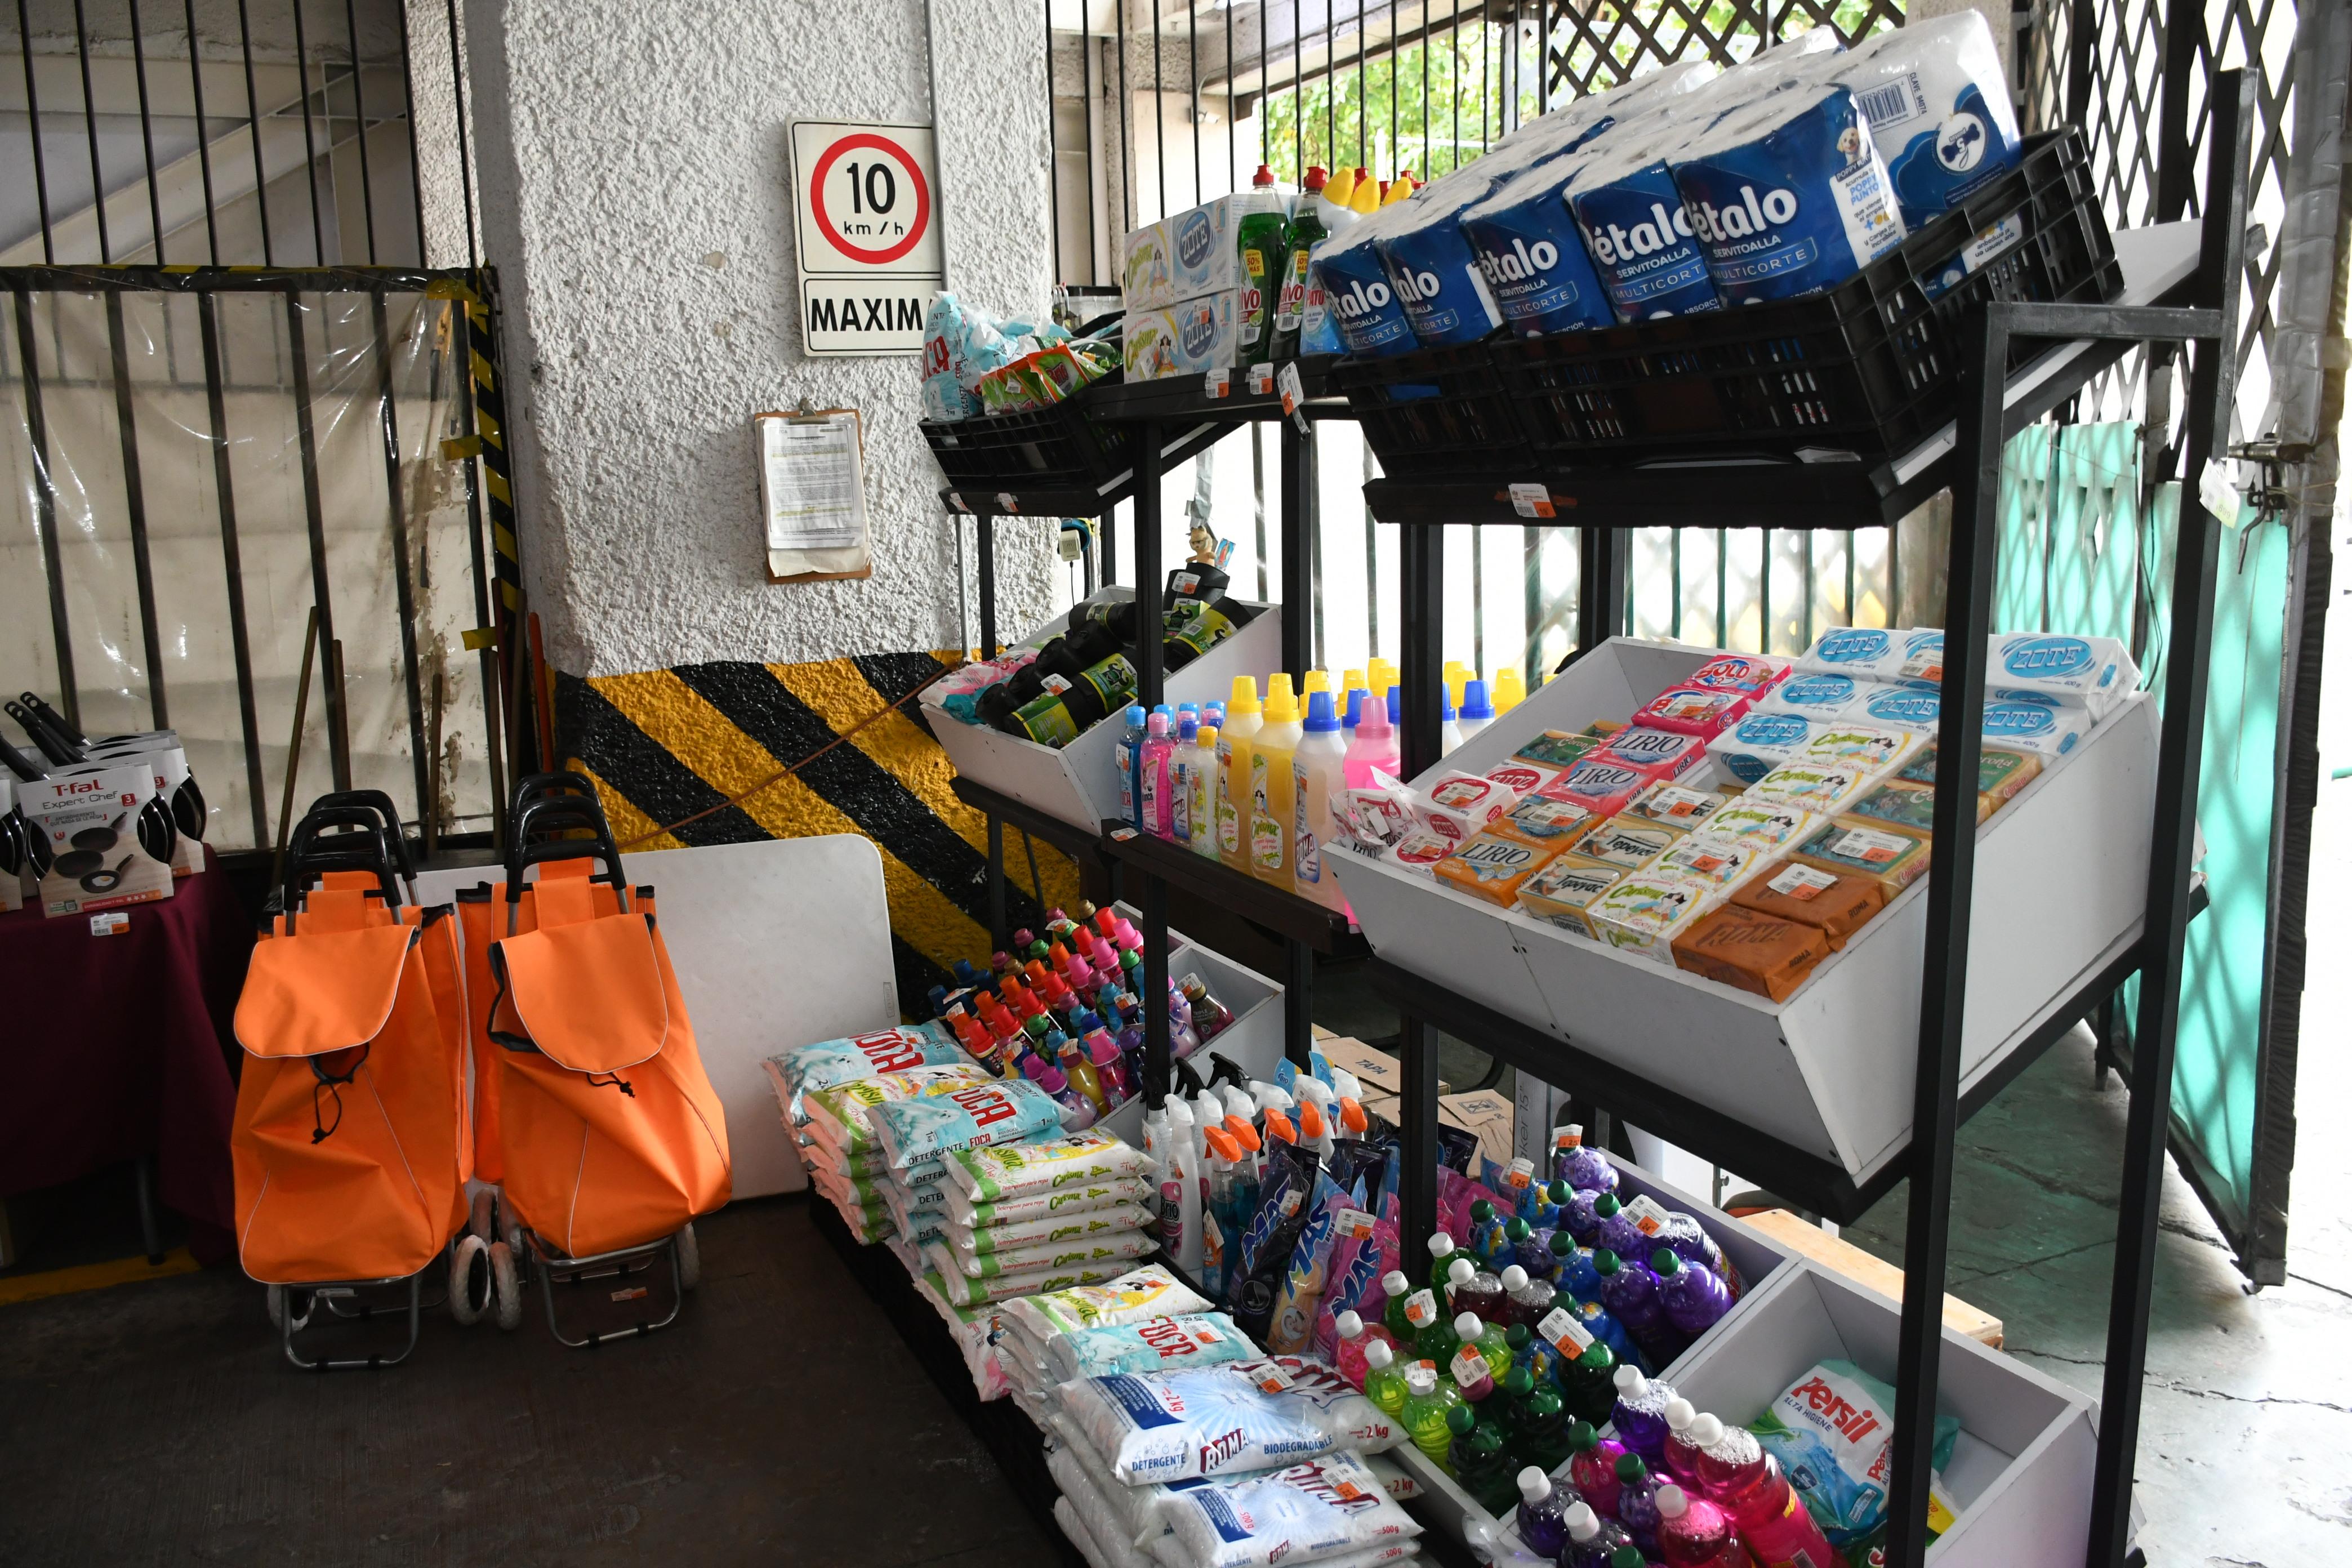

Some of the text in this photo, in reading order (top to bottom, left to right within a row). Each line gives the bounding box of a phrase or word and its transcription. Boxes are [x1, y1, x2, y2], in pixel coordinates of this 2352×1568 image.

[1909, 72, 1928, 115] CLAVE 94074
[1948, 127, 1967, 142] puntos
[1956, 139, 1969, 154] 5
[1837, 162, 1857, 180] POPPY
[1845, 171, 1869, 189] Acumula
[847, 162, 896, 215] 10
[1850, 173, 1877, 196] POPPY
[1851, 182, 1880, 206] PUNTO
[1692, 185, 1797, 243] étalo
[1854, 208, 1865, 219] que
[1865, 204, 1885, 219] empaq
[844, 221, 903, 235] km/h
[1182, 218, 1208, 261] ZOTE
[1713, 235, 1782, 259] SERVITOALLA
[1975, 231, 2015, 258] que vienen en
[1976, 231, 2004, 250] empaque
[1247, 257, 1260, 268] 50%
[1478, 238, 1558, 284] étalo
[1616, 247, 1691, 279] SERVITOALLA
[1713, 248, 1807, 280] MULTICORTE
[1393, 267, 1440, 303] alo
[1499, 279, 1548, 297] SERVITOALLA
[1615, 264, 1701, 299] MULTICORT
[1240, 286, 1260, 310] lvo
[1281, 282, 1304, 302] alvo
[1326, 280, 1390, 320] talo
[811, 298, 932, 332] MAXIM
[1684, 297, 1718, 315] ABSORCI
[1824, 635, 1882, 656] ZOTE
[2011, 645, 2083, 670] ZOTE
[1696, 662, 1750, 680] BOLD
[1787, 683, 1848, 698] ZOTE
[1874, 698, 1940, 716] ZOTE
[1983, 711, 2047, 728] ZOTE
[1741, 723, 1803, 738] ZOTE
[1606, 734, 1685, 753] LIRIO
[1672, 754, 1693, 779] LIRIO
[1562, 768, 1637, 785] LIRIO
[52, 779, 104, 796] T-fal
[43, 791, 118, 810] Expert Chef
[1487, 806, 1500, 822] ZOTE
[1432, 821, 1458, 835] ZOTE
[1295, 833, 1316, 866] ROMA
[1458, 843, 1531, 865] LIRIO
[1606, 834, 1661, 857] Tepeyac
[1556, 874, 1610, 893] Tepeyac
[1847, 899, 1869, 920] ROMA
[1789, 950, 1812, 969] ROMA
[1355, 1059, 1388, 1075] TAPA
[1041, 1118, 1046, 1126] 1
[969, 1133, 992, 1148] FOCA
[908, 1142, 964, 1166] DETERGENTE
[1002, 1182, 1026, 1192] Detergente
[1052, 1170, 1085, 1188] Carisma
[1516, 1179, 1525, 1188] 25
[996, 1203, 1020, 1211] Detergente
[1049, 1193, 1083, 1210] Carisma
[1049, 1225, 1083, 1242] Carisma
[1325, 1221, 1336, 1243] BEBÉ
[1641, 1223, 1651, 1232] 24
[996, 1238, 1021, 1246] Detergente
[1001, 1261, 1026, 1270] Detergente
[1053, 1252, 1087, 1268] Carisma
[990, 1287, 1015, 1296] Detergente
[1041, 1276, 1076, 1292] Carisma
[1562, 1343, 1572, 1353] 31
[1168, 1400, 1185, 1414] kg
[1783, 1396, 1833, 1433] ALTA HIGIENE
[1790, 1376, 1880, 1444] Persil
[1365, 1423, 1389, 1439] 2 kg
[1200, 1428, 1251, 1475] ROMA
[1263, 1434, 1333, 1454] BIODEGRADABLE
[1132, 1453, 1186, 1472] DETERGENTE
[1393, 1477, 1414, 1493] 2 kg
[1269, 1539, 1293, 1565] ROMA
[1311, 1536, 1351, 1551] BIODEGRADABLE
